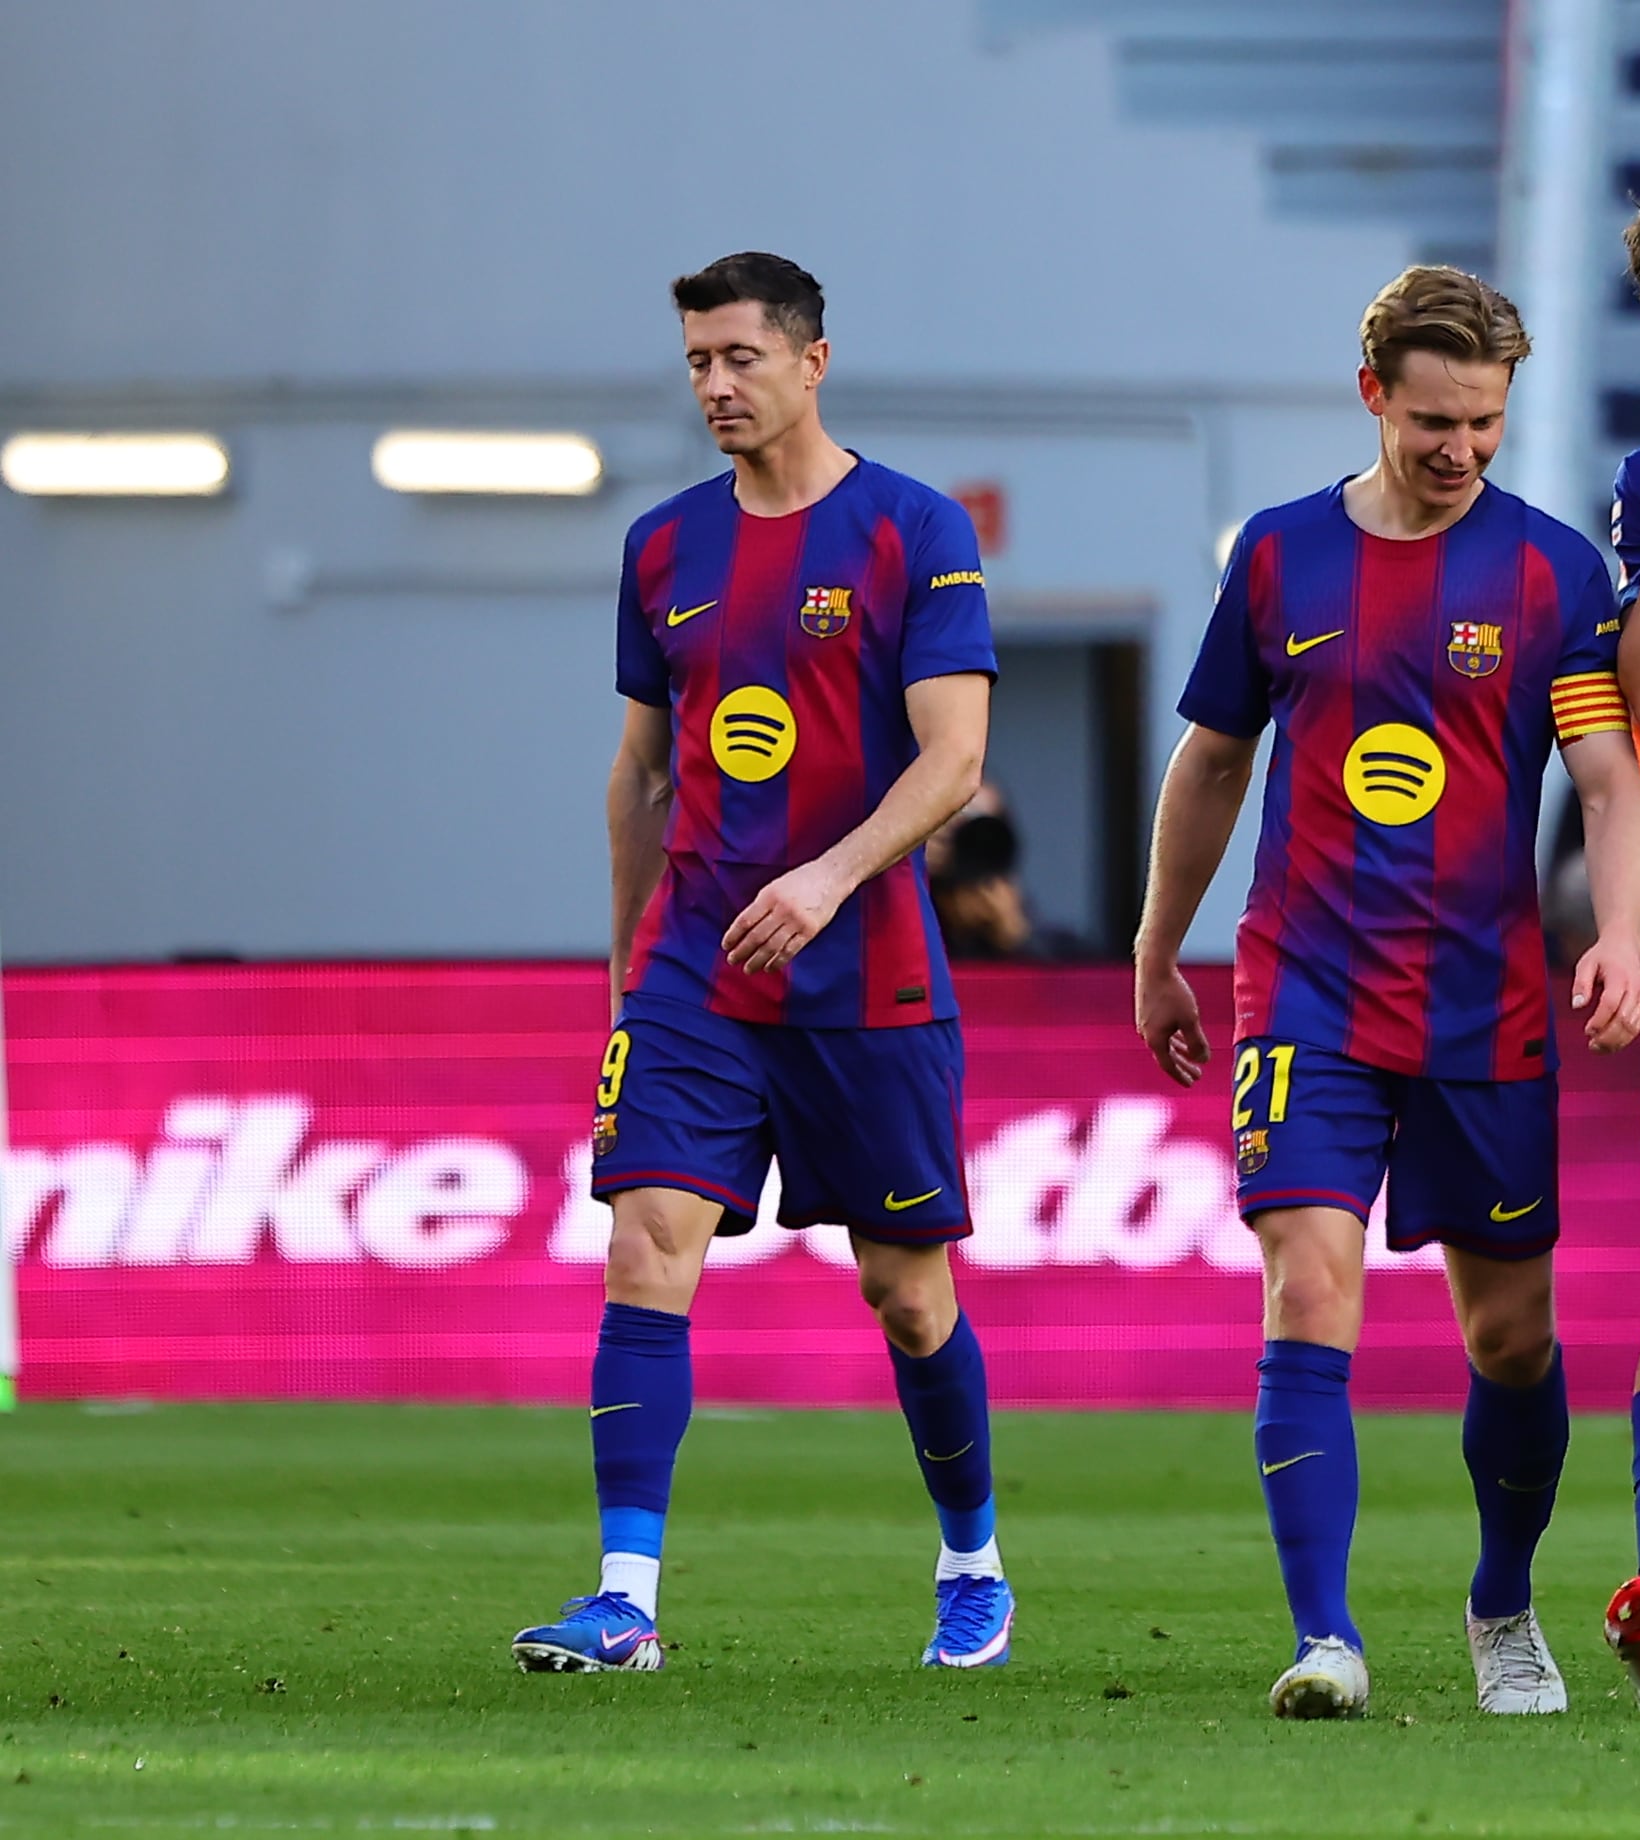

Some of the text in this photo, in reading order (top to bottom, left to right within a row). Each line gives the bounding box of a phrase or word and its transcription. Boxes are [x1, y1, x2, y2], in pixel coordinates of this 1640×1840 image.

[597, 1029, 631, 1108] 9
[1232, 1045, 1296, 1132] 21
[0, 1093, 530, 1271] nike
